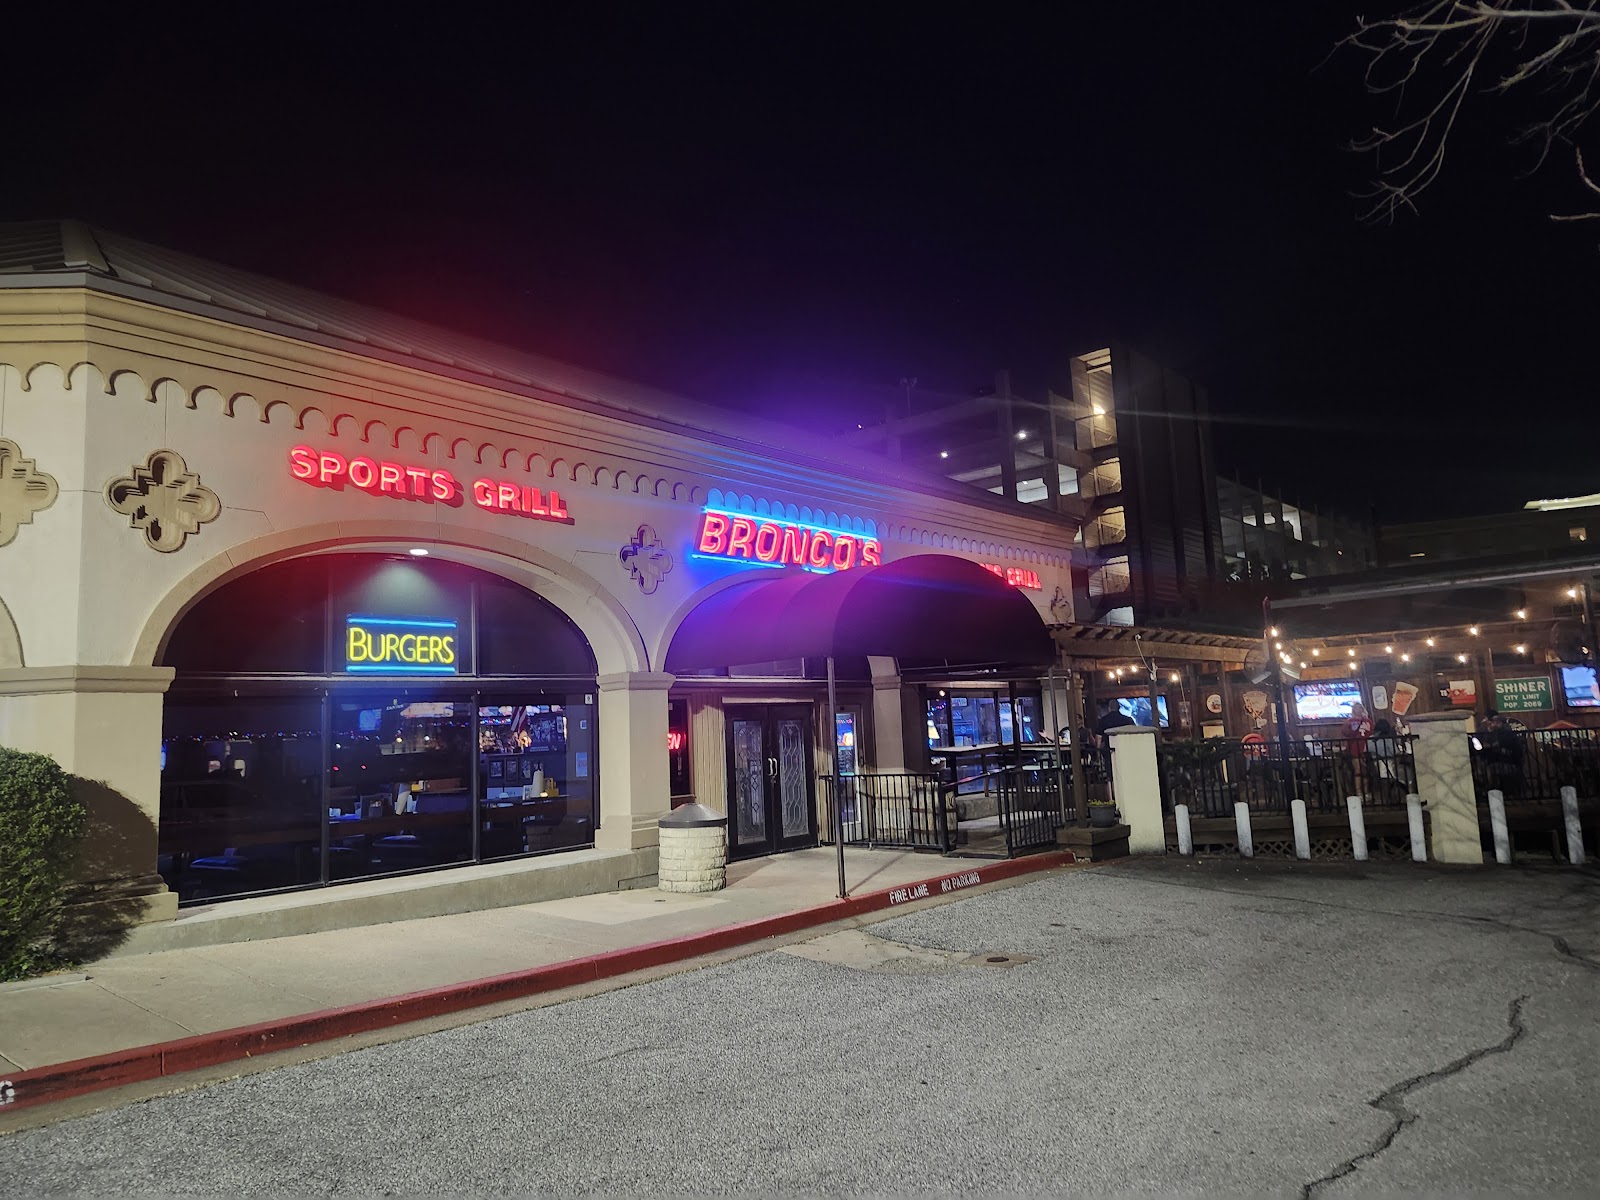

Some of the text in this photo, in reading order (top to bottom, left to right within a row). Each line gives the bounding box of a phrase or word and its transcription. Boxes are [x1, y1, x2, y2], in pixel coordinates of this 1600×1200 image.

[290, 445, 570, 520] SPORTS GRILL
[698, 510, 881, 572] BRONCO'S
[1006, 566, 1042, 589] GRILL
[348, 626, 455, 664] BURGERS
[1495, 681, 1546, 694] SHINER
[889, 872, 980, 904] FIRE LANE NO PARKING
